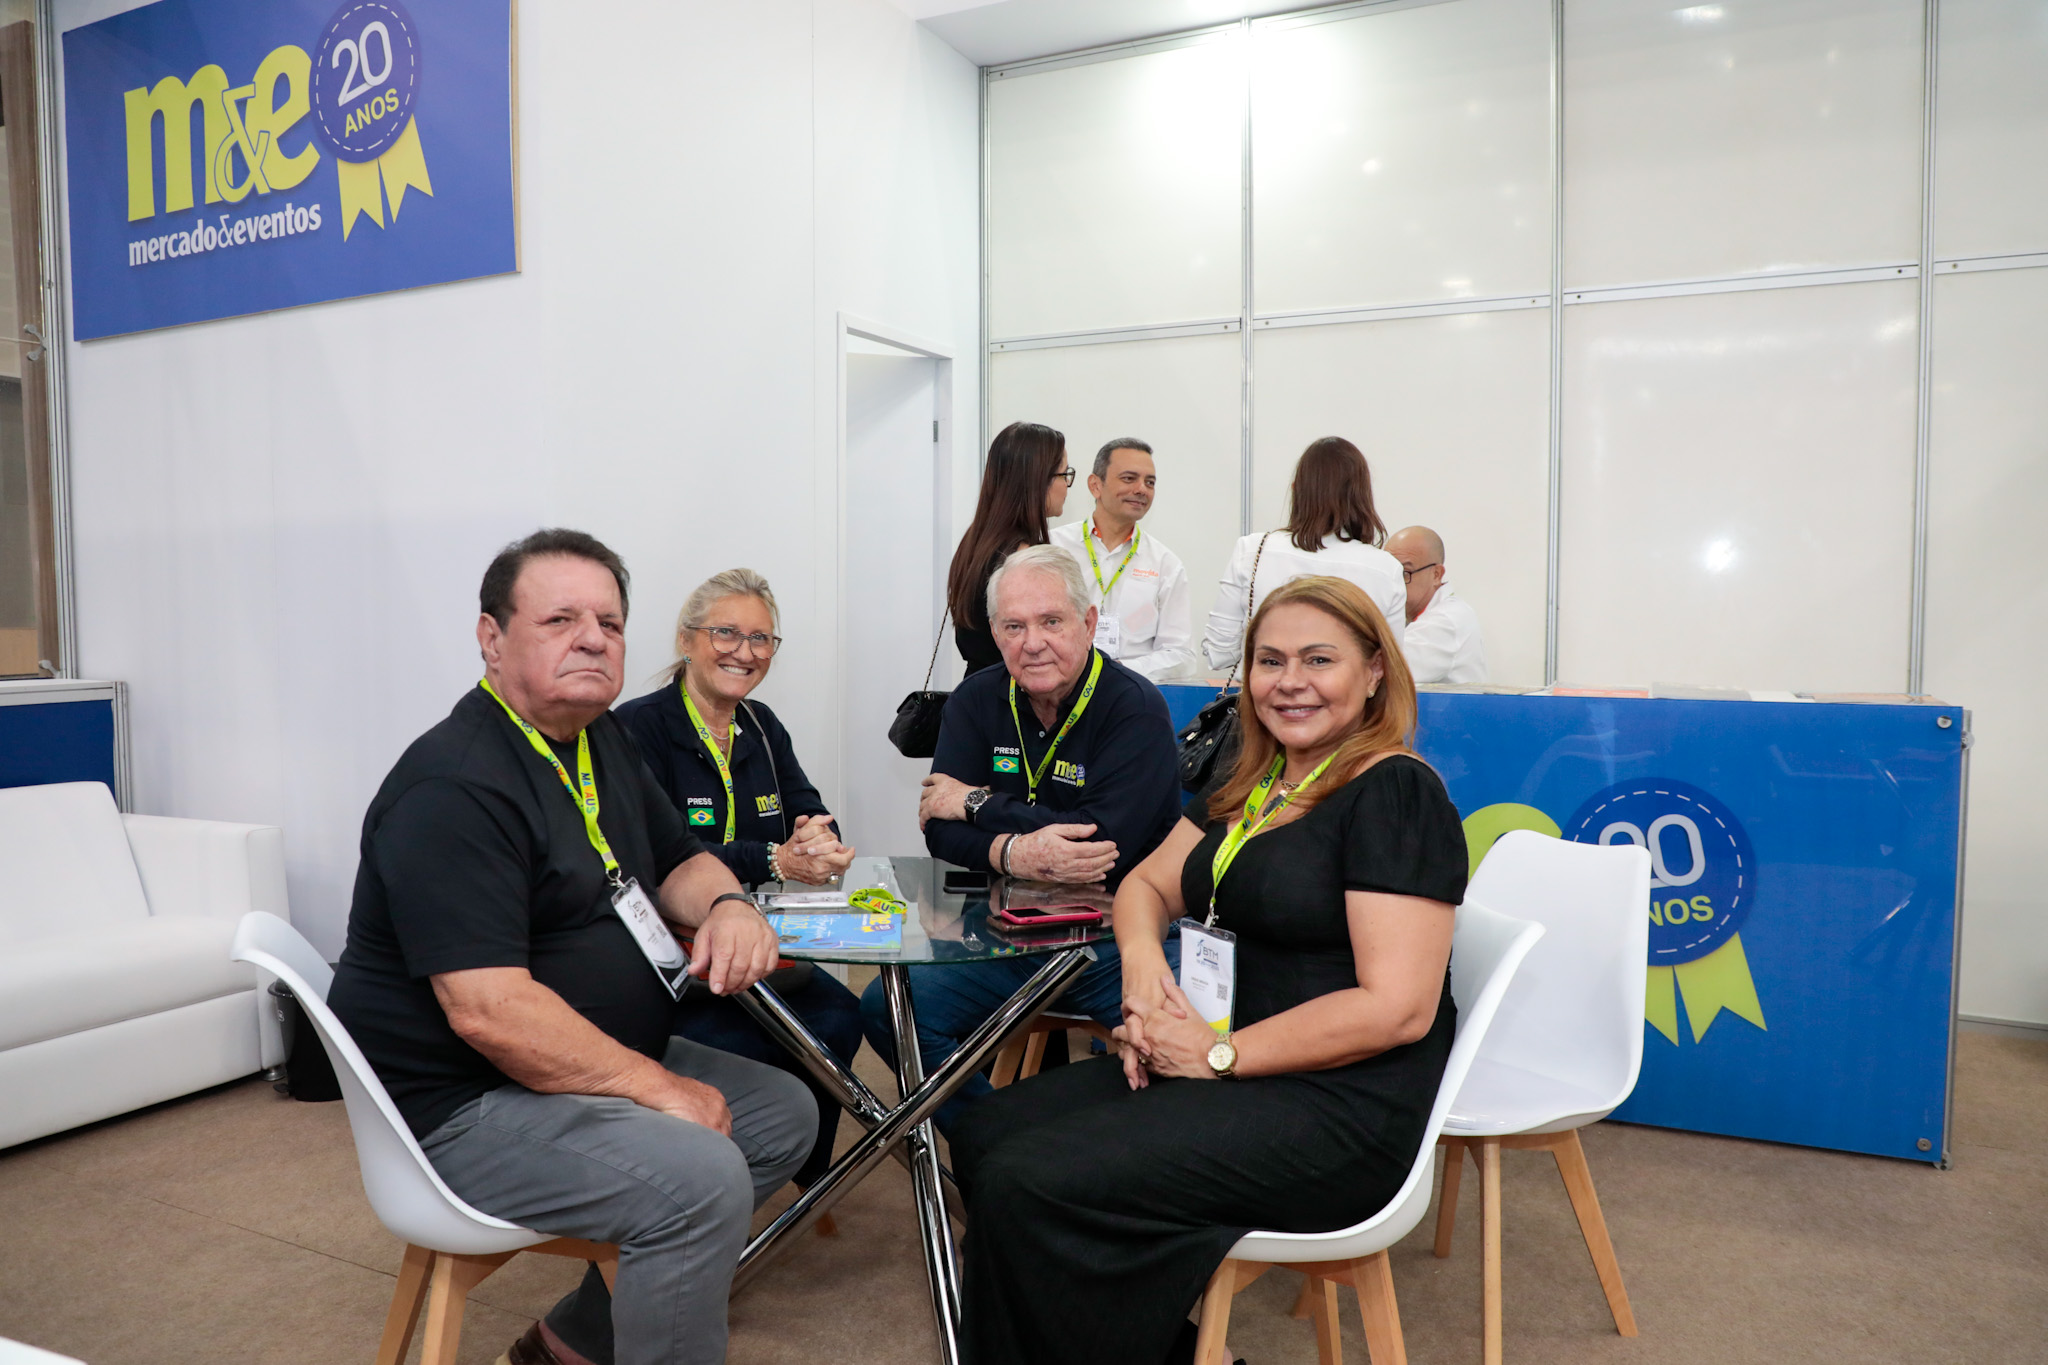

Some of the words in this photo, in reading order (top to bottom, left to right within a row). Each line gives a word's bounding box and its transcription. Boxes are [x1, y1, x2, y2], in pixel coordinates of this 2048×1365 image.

[332, 21, 393, 107] 20
[124, 44, 321, 222] m&e
[345, 88, 400, 138] ANOS
[129, 202, 322, 267] mercado&eventos
[994, 746, 1020, 756] PRESS
[580, 772, 597, 814] MANAUS
[715, 754, 734, 794] MANAUS
[1260, 772, 1273, 789] GAV
[687, 797, 713, 806] PRESS
[1648, 896, 1714, 926] NOS
[1203, 946, 1219, 960] BTM
